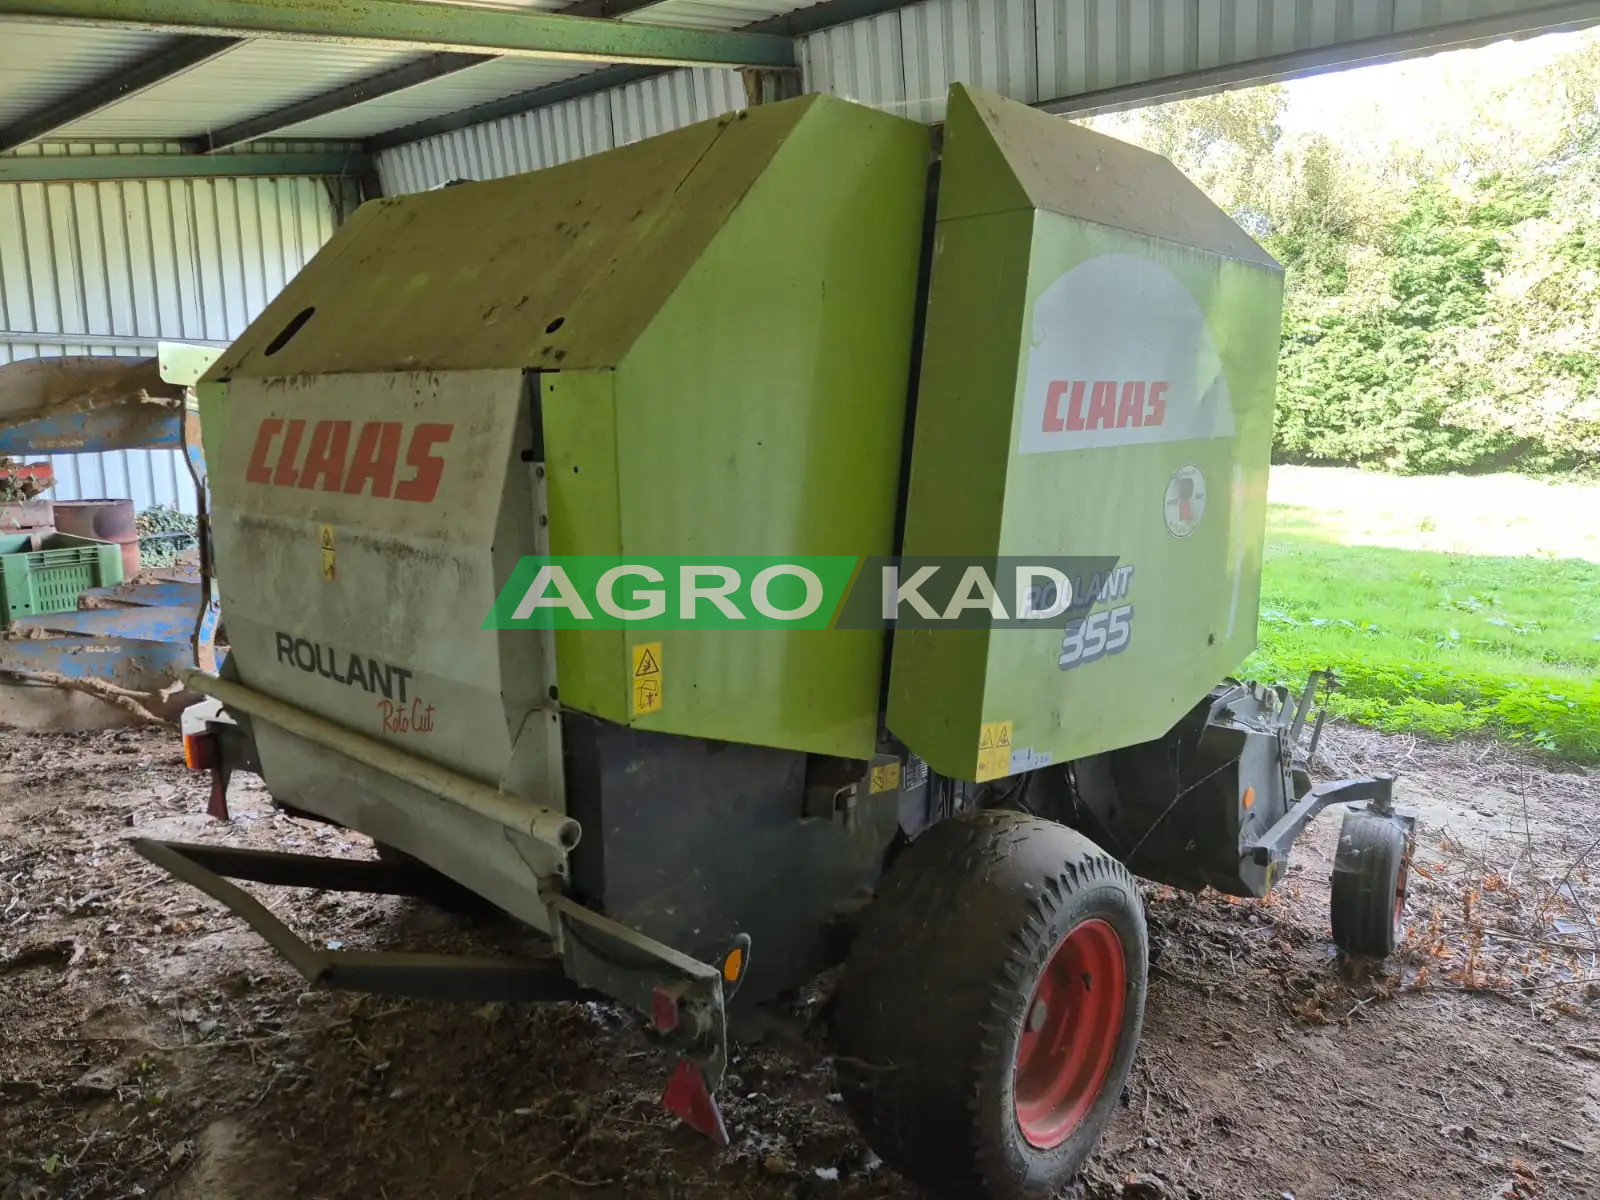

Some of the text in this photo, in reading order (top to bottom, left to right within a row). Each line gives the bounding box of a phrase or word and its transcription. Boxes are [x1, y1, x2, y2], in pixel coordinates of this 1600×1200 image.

[1042, 380, 1170, 432] CLAAS
[245, 418, 454, 502] CLAAS
[1019, 566, 1134, 621] ROLLANT
[275, 631, 413, 703] ROLLANT
[1059, 605, 1134, 671] 355
[378, 697, 436, 736] Roto Cut
